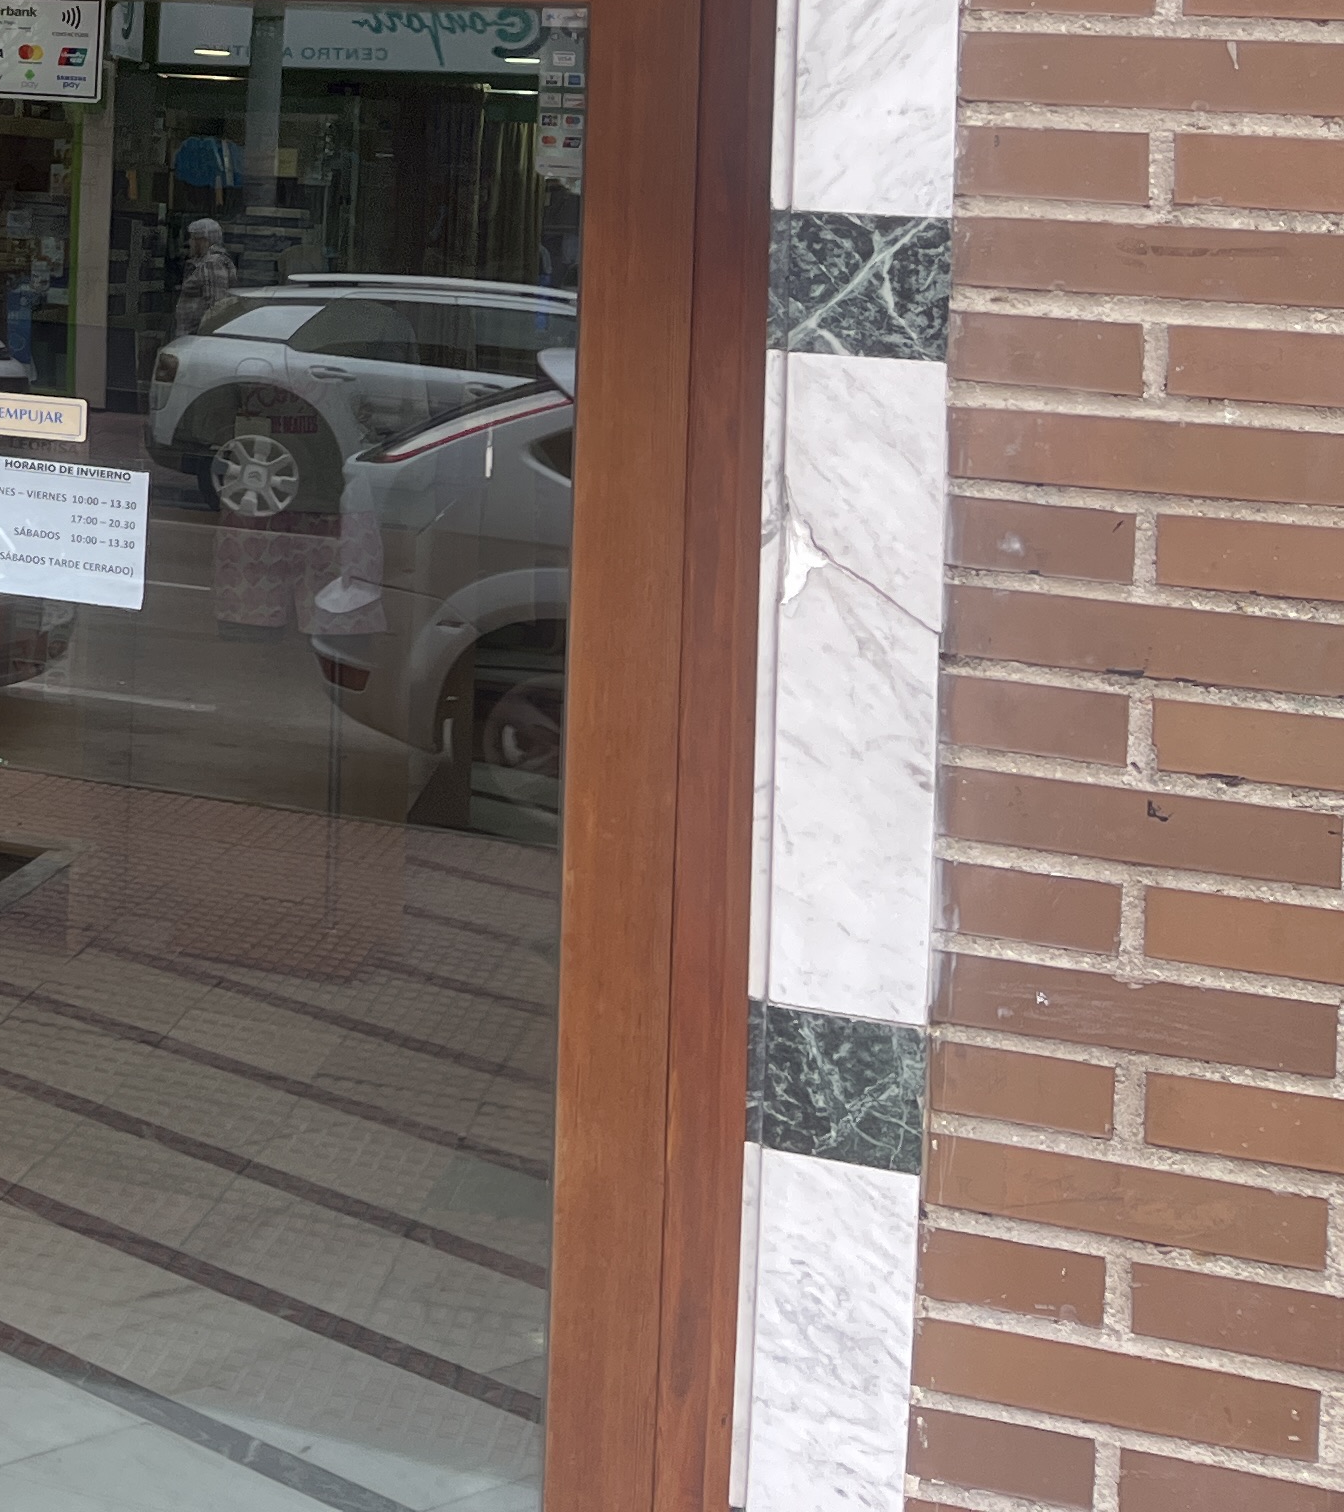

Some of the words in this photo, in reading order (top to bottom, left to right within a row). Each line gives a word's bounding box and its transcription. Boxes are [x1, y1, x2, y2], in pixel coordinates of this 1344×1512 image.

[4, 459, 56, 473] HORARIO
[59, 465, 74, 475] DE
[76, 467, 131, 481] INVIERNO
[26, 490, 67, 503] VIERNES
[72, 494, 99, 506] 10:00
[110, 499, 137, 510] 13.30
[71, 514, 97, 526] 17:00
[109, 519, 135, 530] 20.30
[14, 526, 61, 541] SÁBADOS
[71, 534, 97, 545] 10:00
[108, 539, 135, 550] 13.30
[49, 557, 80, 570] TARDE
[83, 562, 134, 577] CERRADO)
